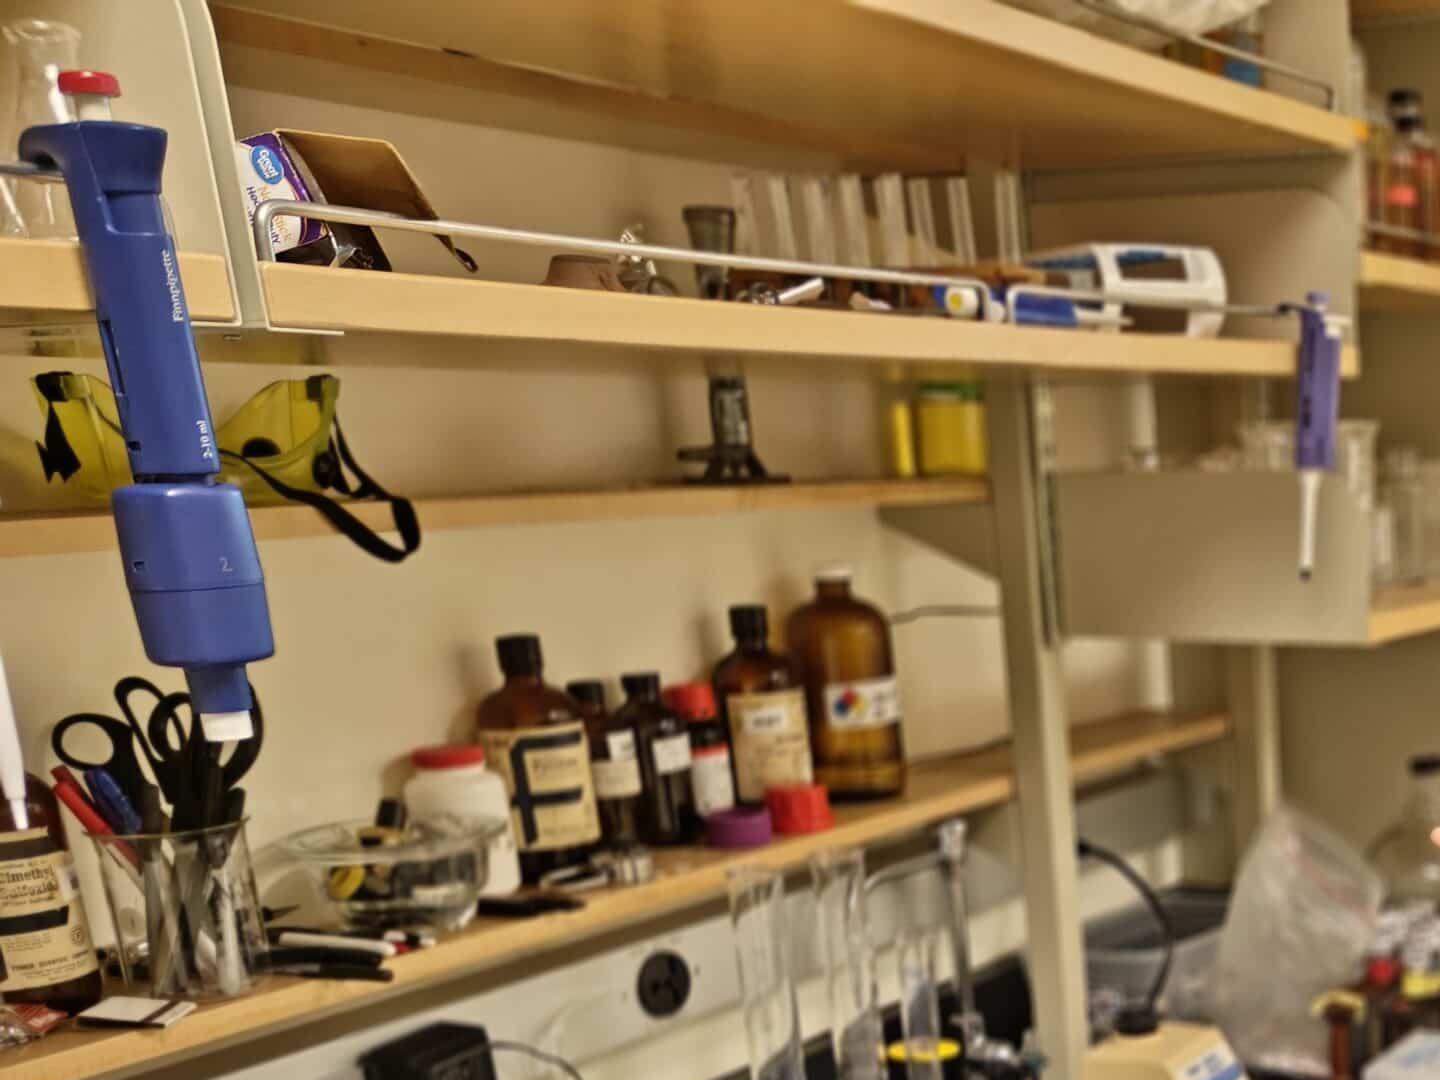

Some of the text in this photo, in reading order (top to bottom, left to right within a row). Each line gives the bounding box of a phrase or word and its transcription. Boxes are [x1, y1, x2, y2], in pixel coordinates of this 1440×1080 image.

[162, 249, 184, 322] Finnpipette
[196, 420, 213, 459] 2-10 ml
